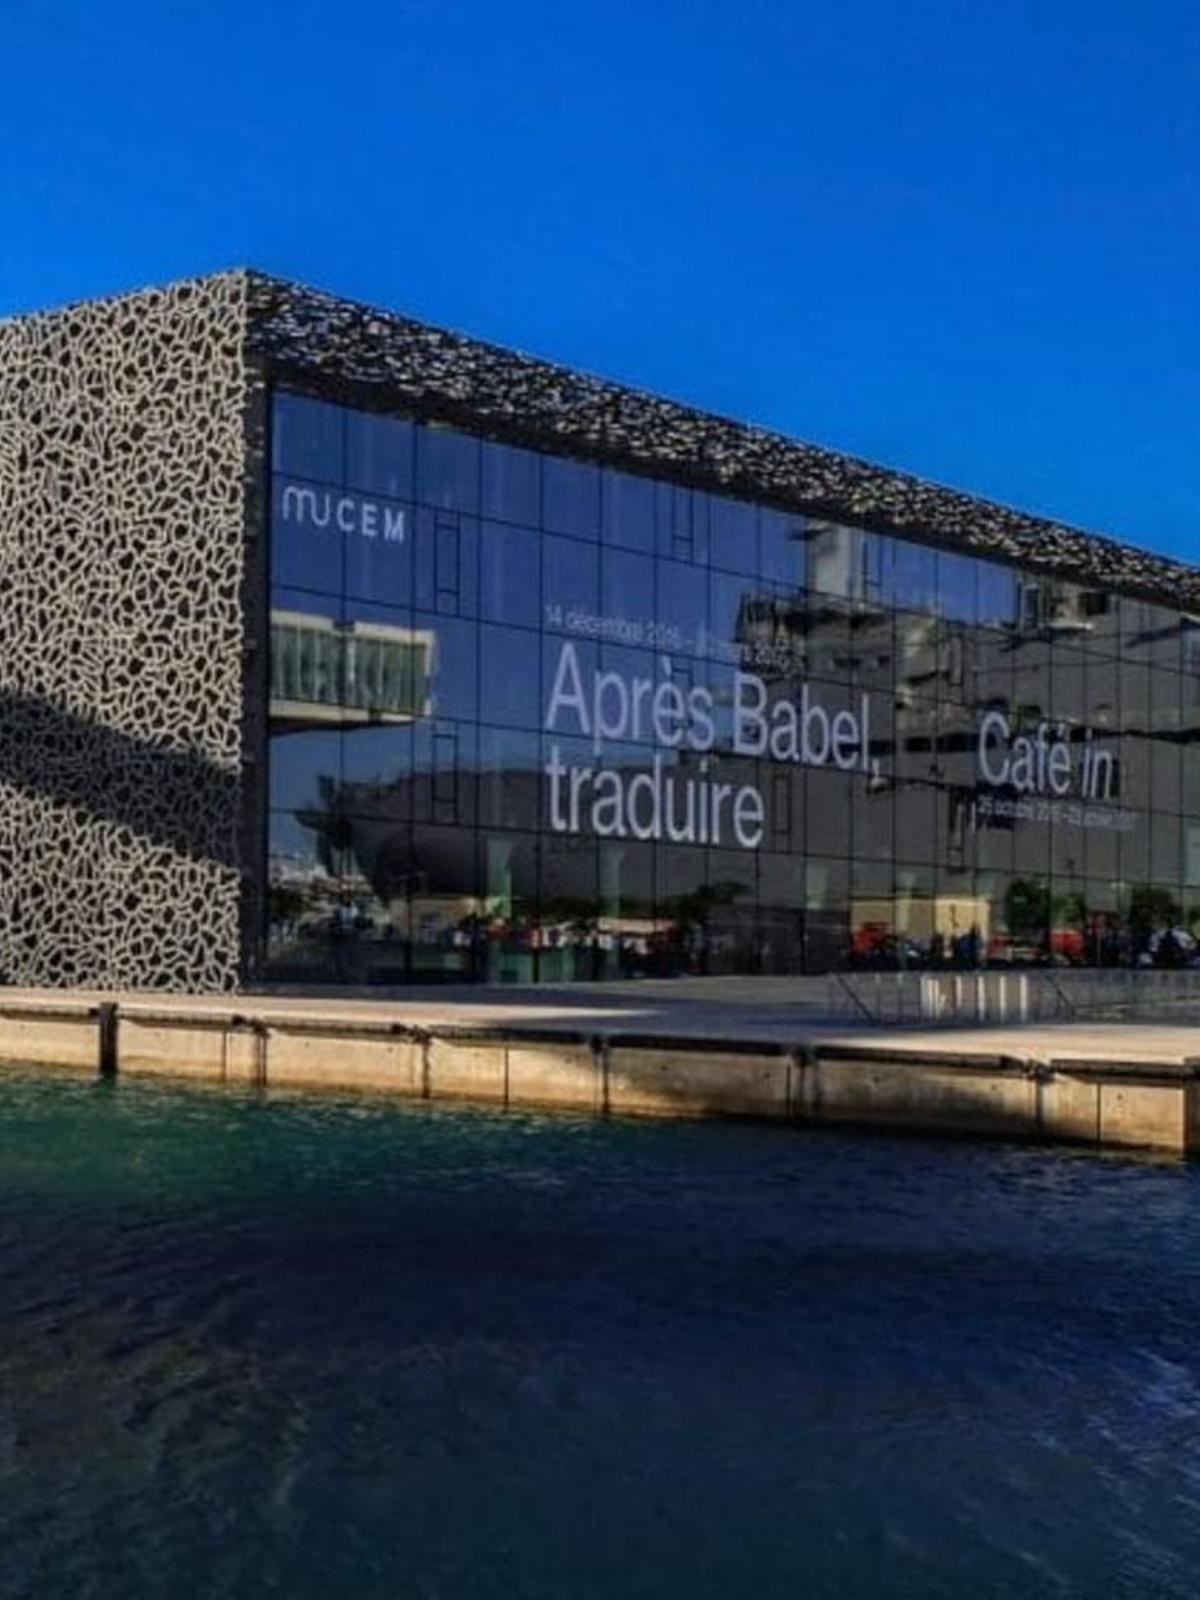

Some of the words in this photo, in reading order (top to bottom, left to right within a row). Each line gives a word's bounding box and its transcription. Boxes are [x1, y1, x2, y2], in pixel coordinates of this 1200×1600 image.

[546, 642, 714, 755] Après
[732, 672, 880, 791] Babel,
[979, 711, 1071, 794] Café
[1081, 728, 1112, 798] in
[545, 746, 765, 848] traduire
